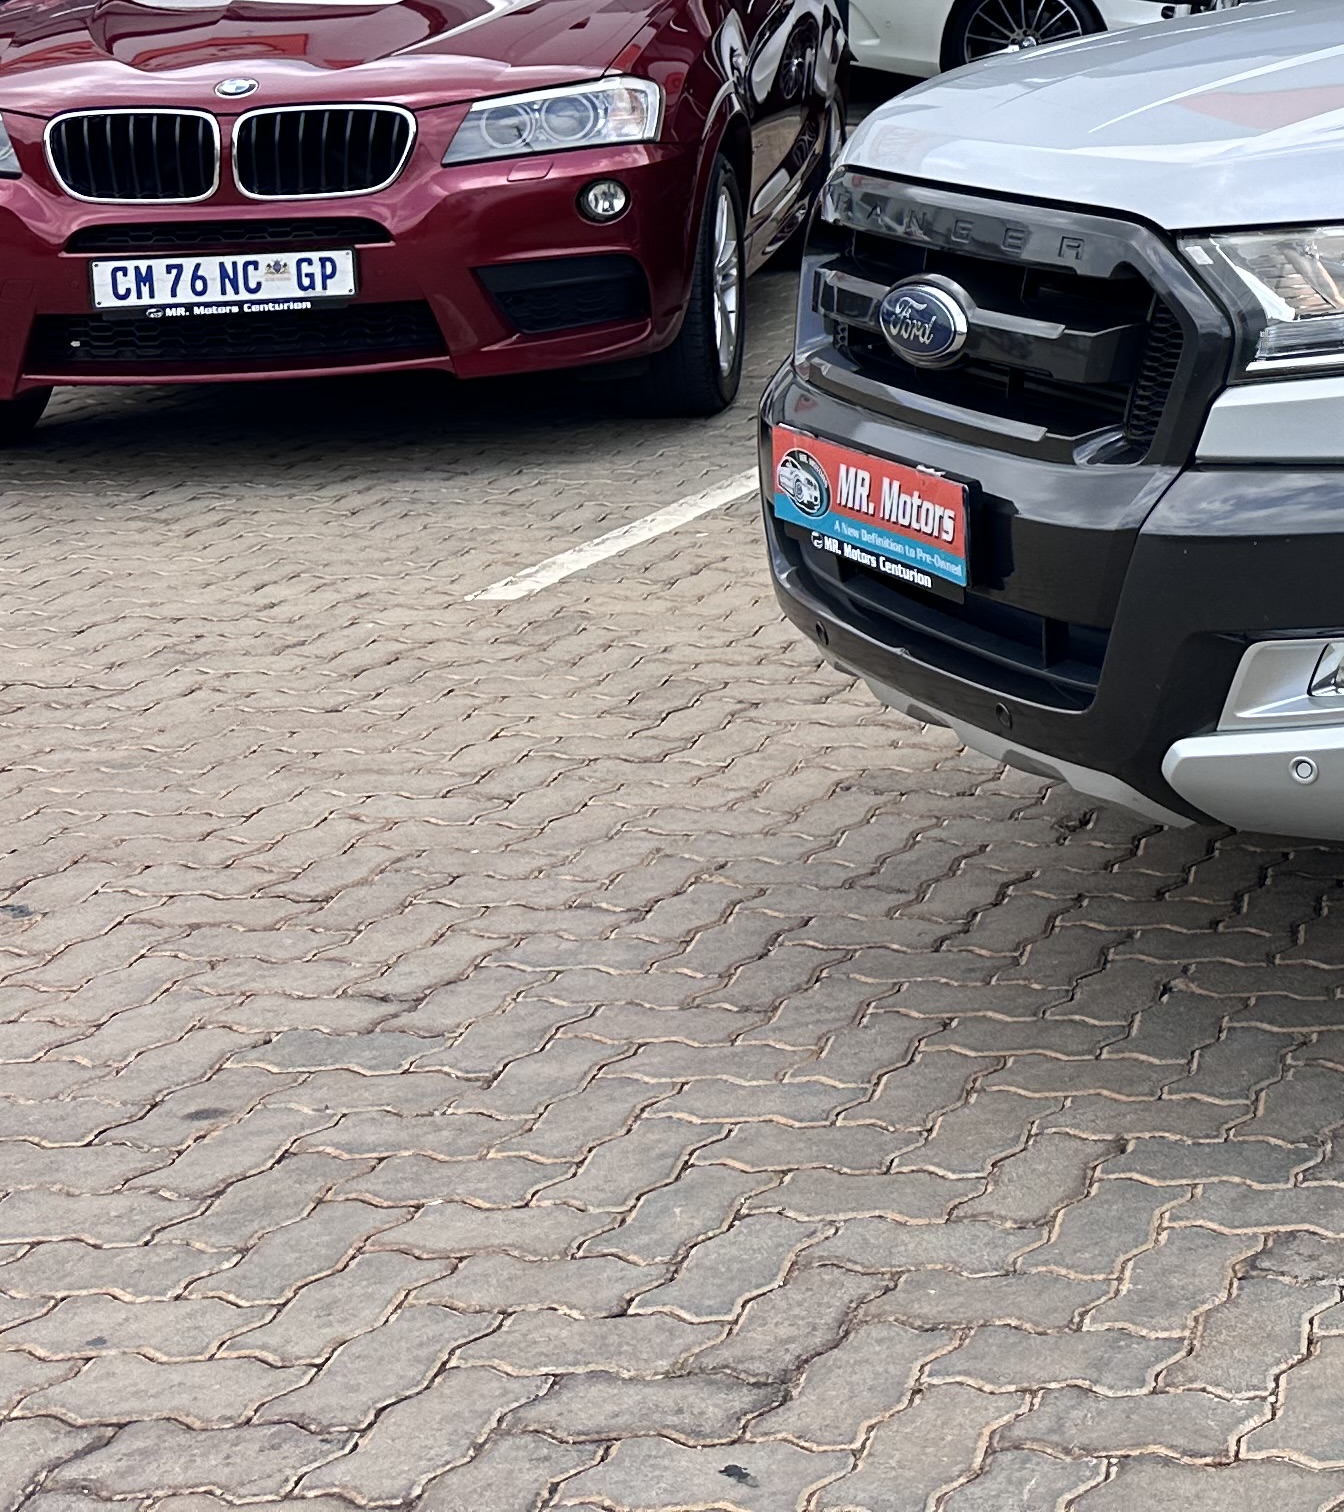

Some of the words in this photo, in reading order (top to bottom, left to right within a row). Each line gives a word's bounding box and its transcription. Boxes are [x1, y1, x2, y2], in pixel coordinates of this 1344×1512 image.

[834, 191, 1085, 261] RANGER
[110, 265, 155, 300] CM
[166, 263, 208, 297] 76
[218, 260, 262, 296] NC
[295, 256, 338, 292] GP
[165, 307, 190, 317] MR.
[193, 304, 239, 315] Motors
[243, 300, 312, 313] Centurion
[889, 295, 937, 345] Ford
[836, 462, 875, 516] MR.
[879, 476, 956, 543] Motors
[824, 534, 842, 555] MR.
[843, 542, 877, 568] Motors
[878, 556, 932, 588] Centurion
[860, 527, 904, 554] Definition
[904, 543, 916, 558] to
